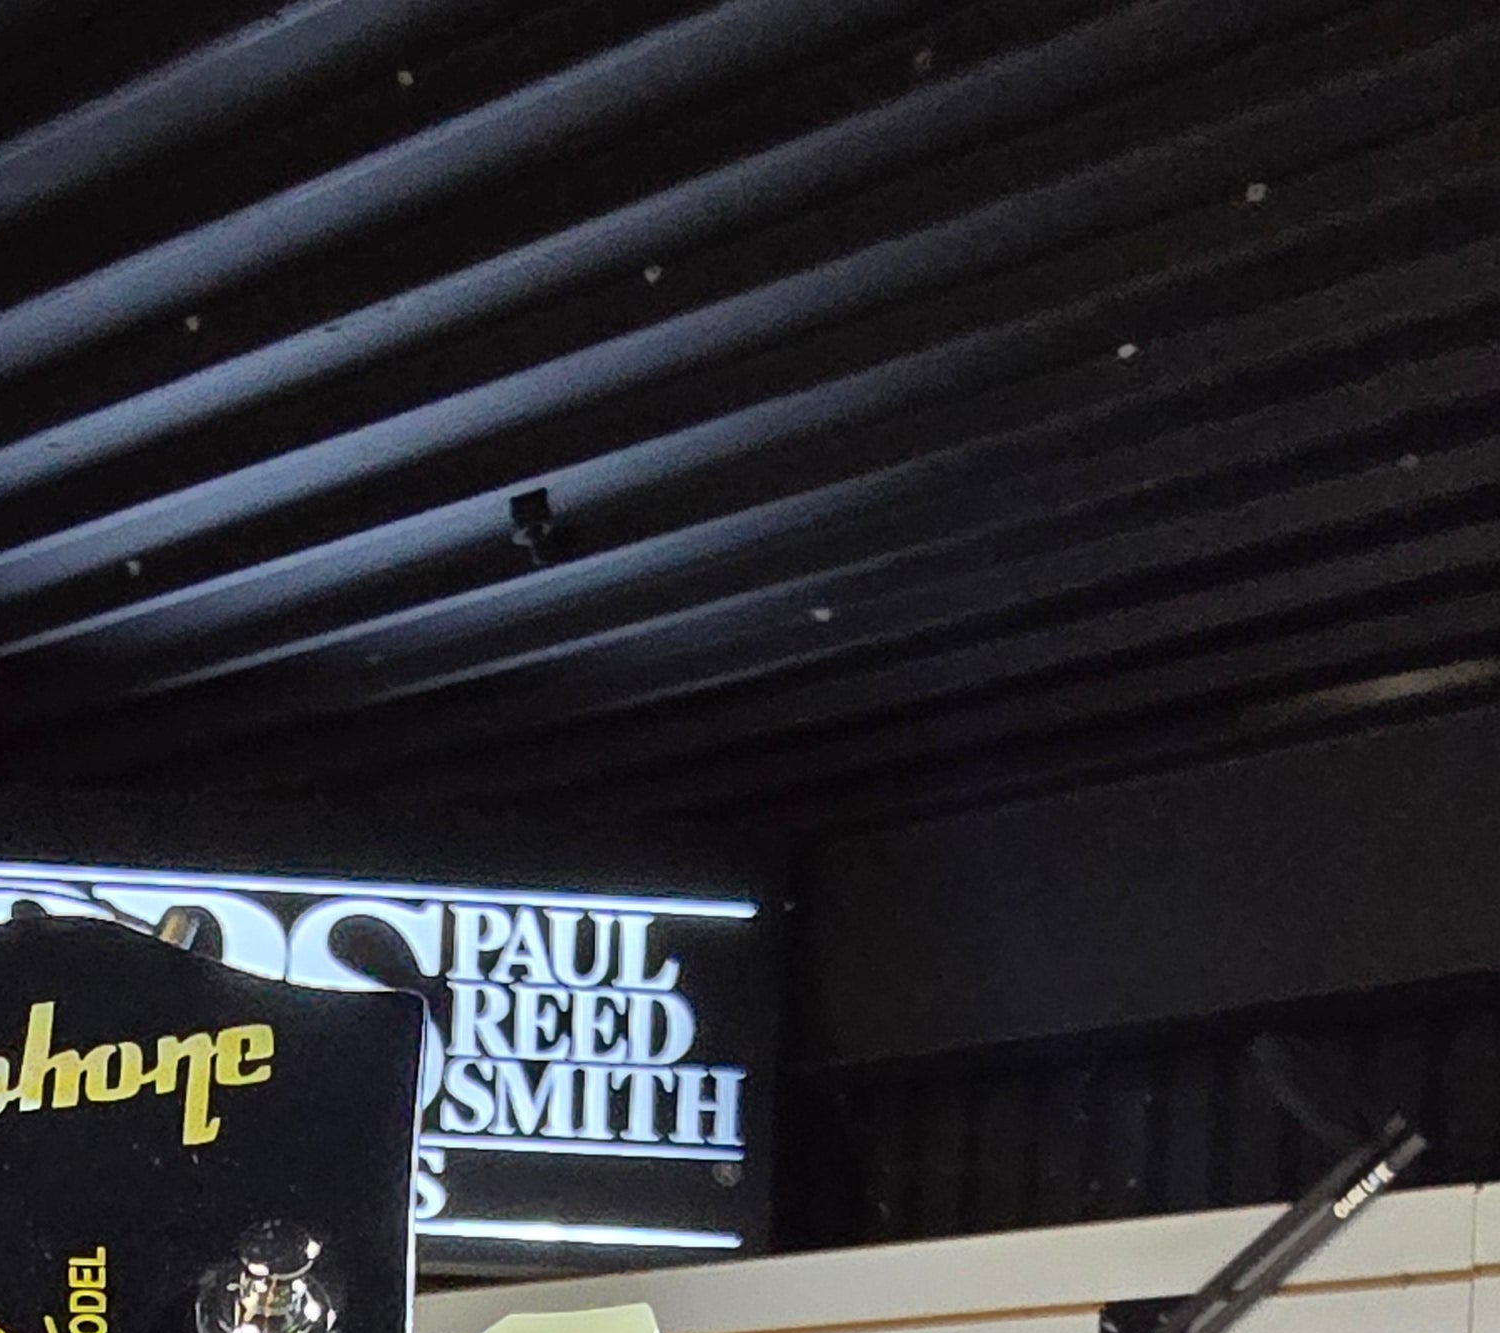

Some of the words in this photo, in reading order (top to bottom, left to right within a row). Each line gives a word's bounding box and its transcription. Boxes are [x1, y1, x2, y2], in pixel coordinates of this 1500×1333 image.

[446, 902, 682, 991] PAUL
[446, 980, 697, 1065] REED
[439, 1055, 748, 1146] SMITH
